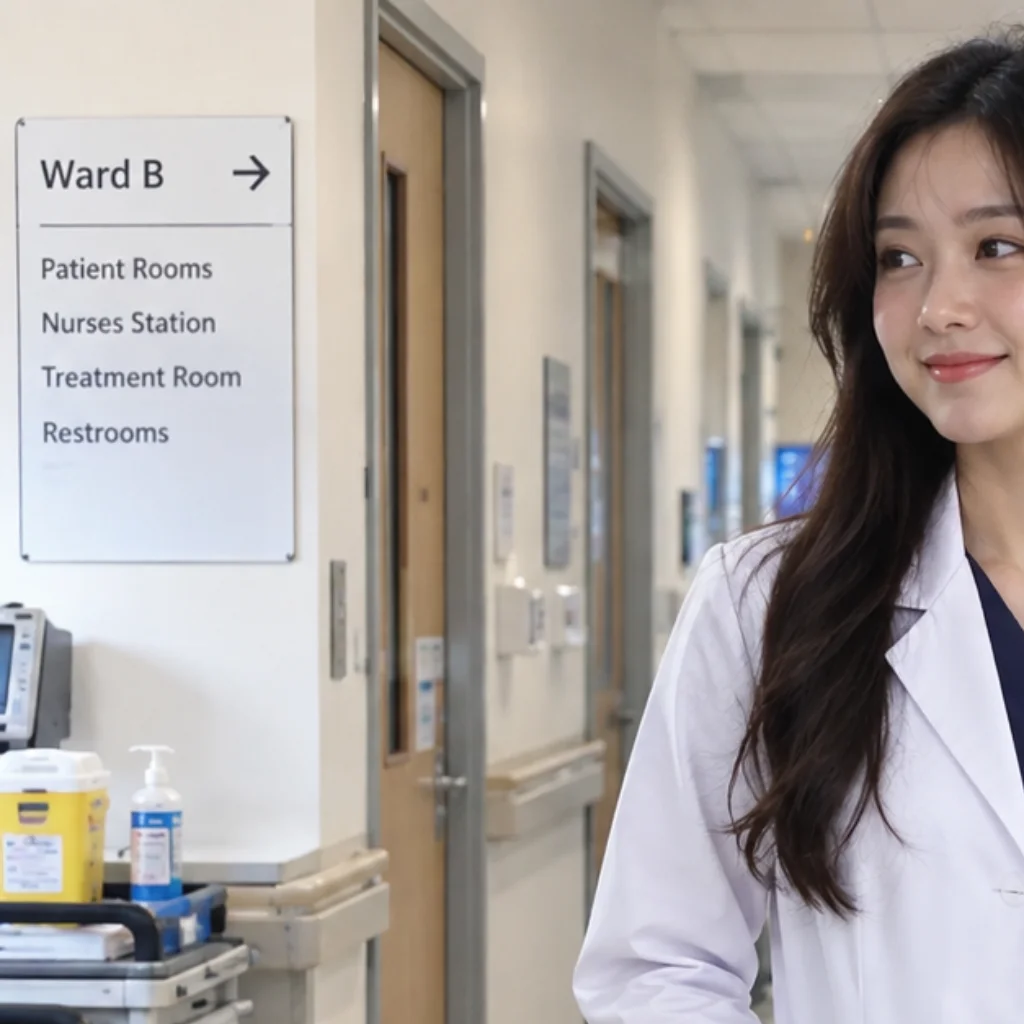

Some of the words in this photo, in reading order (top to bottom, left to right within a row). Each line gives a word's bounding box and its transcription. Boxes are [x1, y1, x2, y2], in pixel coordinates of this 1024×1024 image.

[40, 158, 130, 190] Ward
[143, 159, 164, 189] B
[41, 257, 125, 280] Patient
[133, 257, 213, 280] Rooms
[42, 312, 124, 334] Nurses
[131, 311, 216, 334] Station
[41, 365, 165, 388] Treatment
[173, 365, 242, 388] Room
[43, 421, 170, 444] Restrooms
